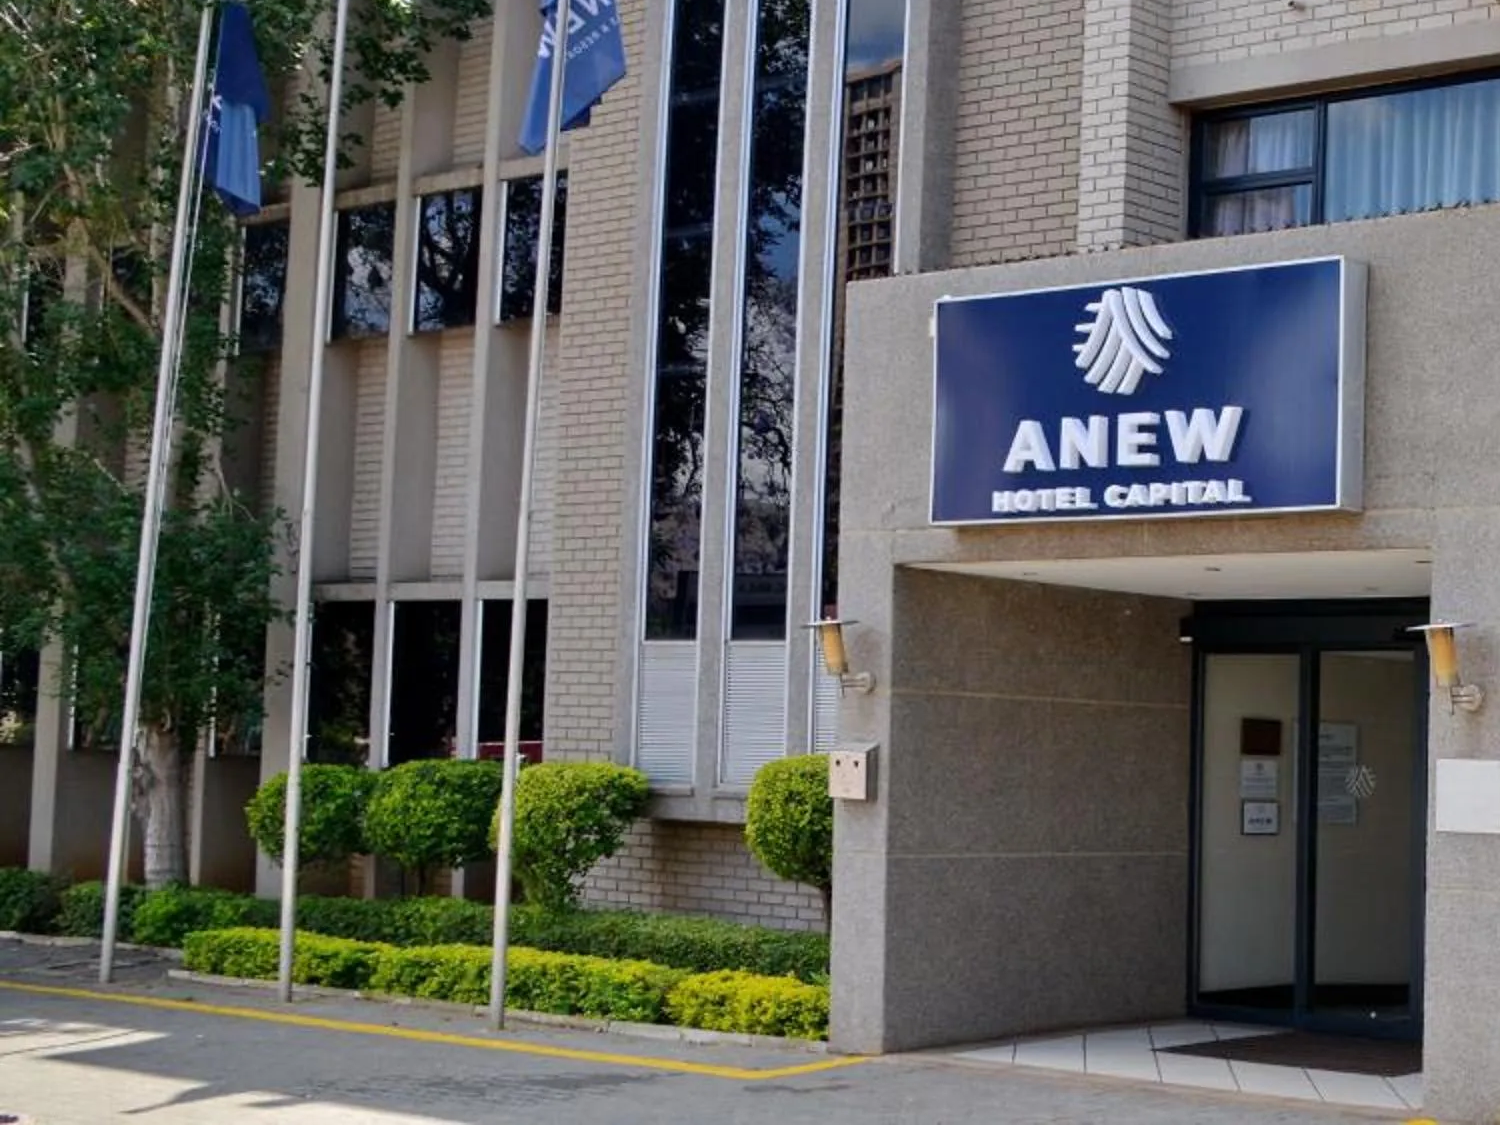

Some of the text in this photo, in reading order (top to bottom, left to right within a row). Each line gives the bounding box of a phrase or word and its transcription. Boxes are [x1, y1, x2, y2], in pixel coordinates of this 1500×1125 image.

[1003, 406, 1244, 473] ANEW
[992, 478, 1252, 513] HOTEL CAPITAL
